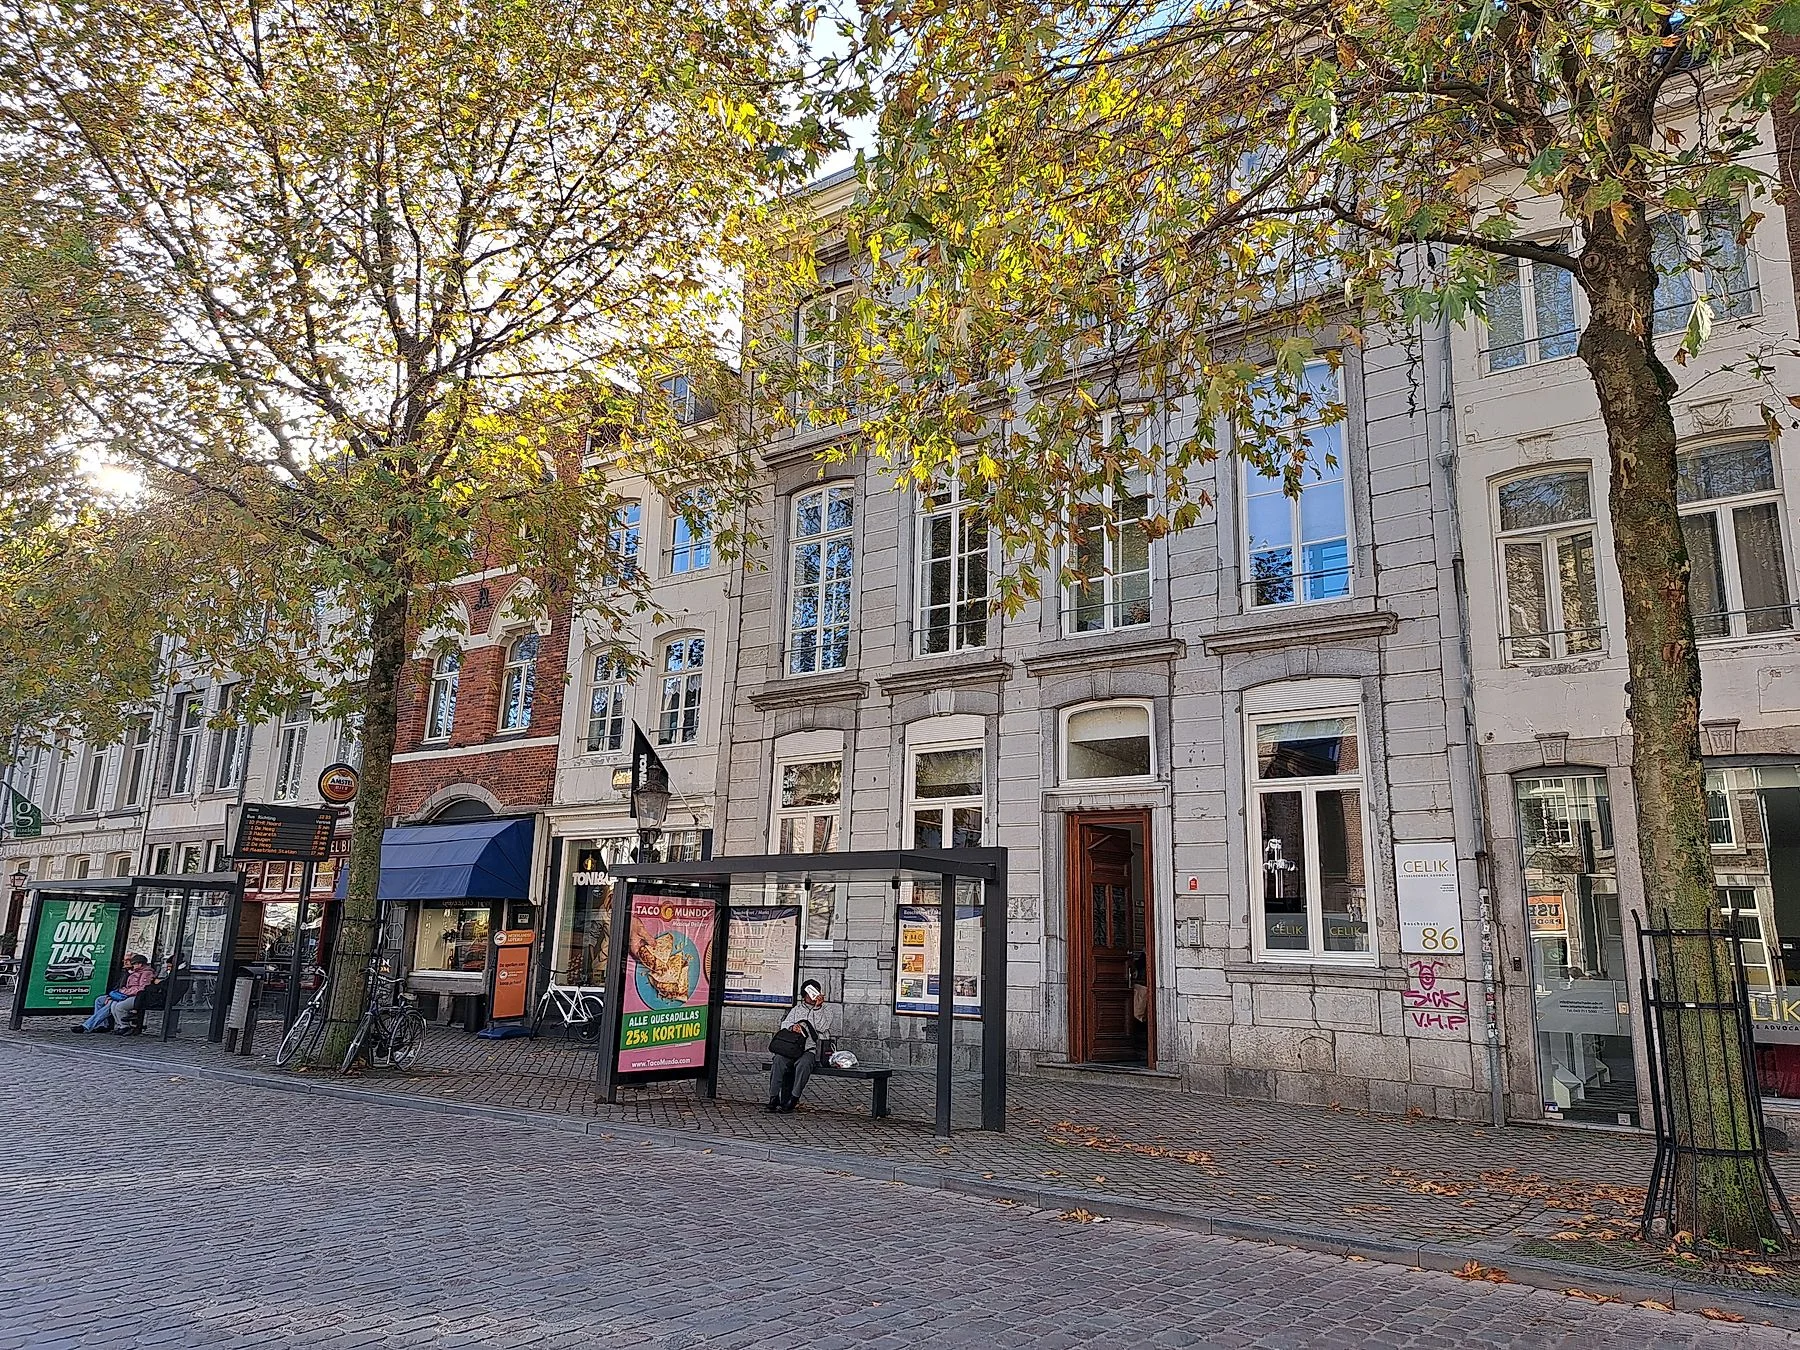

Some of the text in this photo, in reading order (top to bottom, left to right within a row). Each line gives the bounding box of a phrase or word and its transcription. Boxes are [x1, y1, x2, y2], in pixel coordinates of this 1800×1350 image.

[1403, 859, 1448, 873] CELIK
[66, 901, 97, 920] WE
[636, 906, 708, 918] TACO MUNDO
[53, 921, 103, 943] OWN
[1271, 925, 1303, 935] CELIK
[1330, 926, 1362, 936] CELIK
[1422, 927, 1458, 950] 86
[629, 1011, 699, 1027] ALLE QUESADILLAS
[626, 1022, 700, 1045] 25% KORTING
[632, 1058, 691, 1067] www.TacoMundo.com
